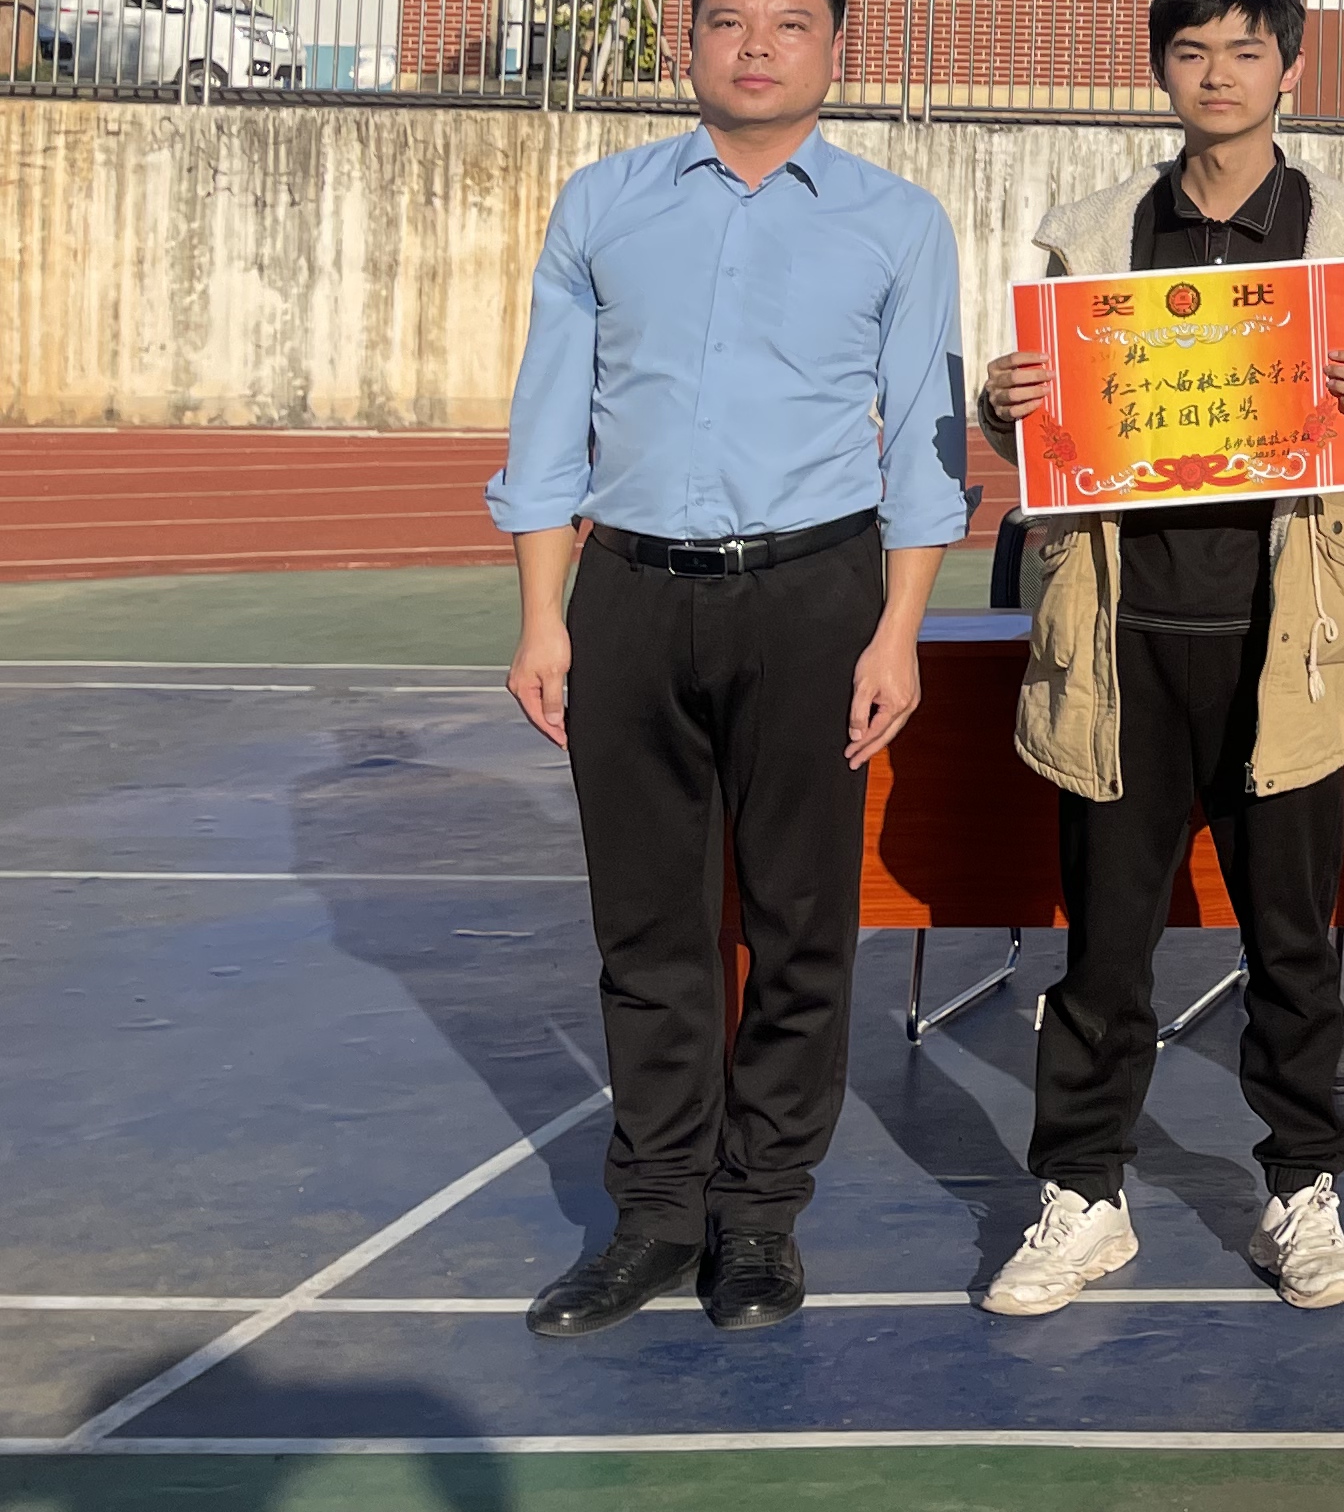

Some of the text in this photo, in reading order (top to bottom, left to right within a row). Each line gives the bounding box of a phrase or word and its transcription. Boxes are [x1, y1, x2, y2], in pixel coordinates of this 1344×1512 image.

[1124, 343, 1150, 369] 班
[1117, 395, 1259, 439] 最佳团结奖
